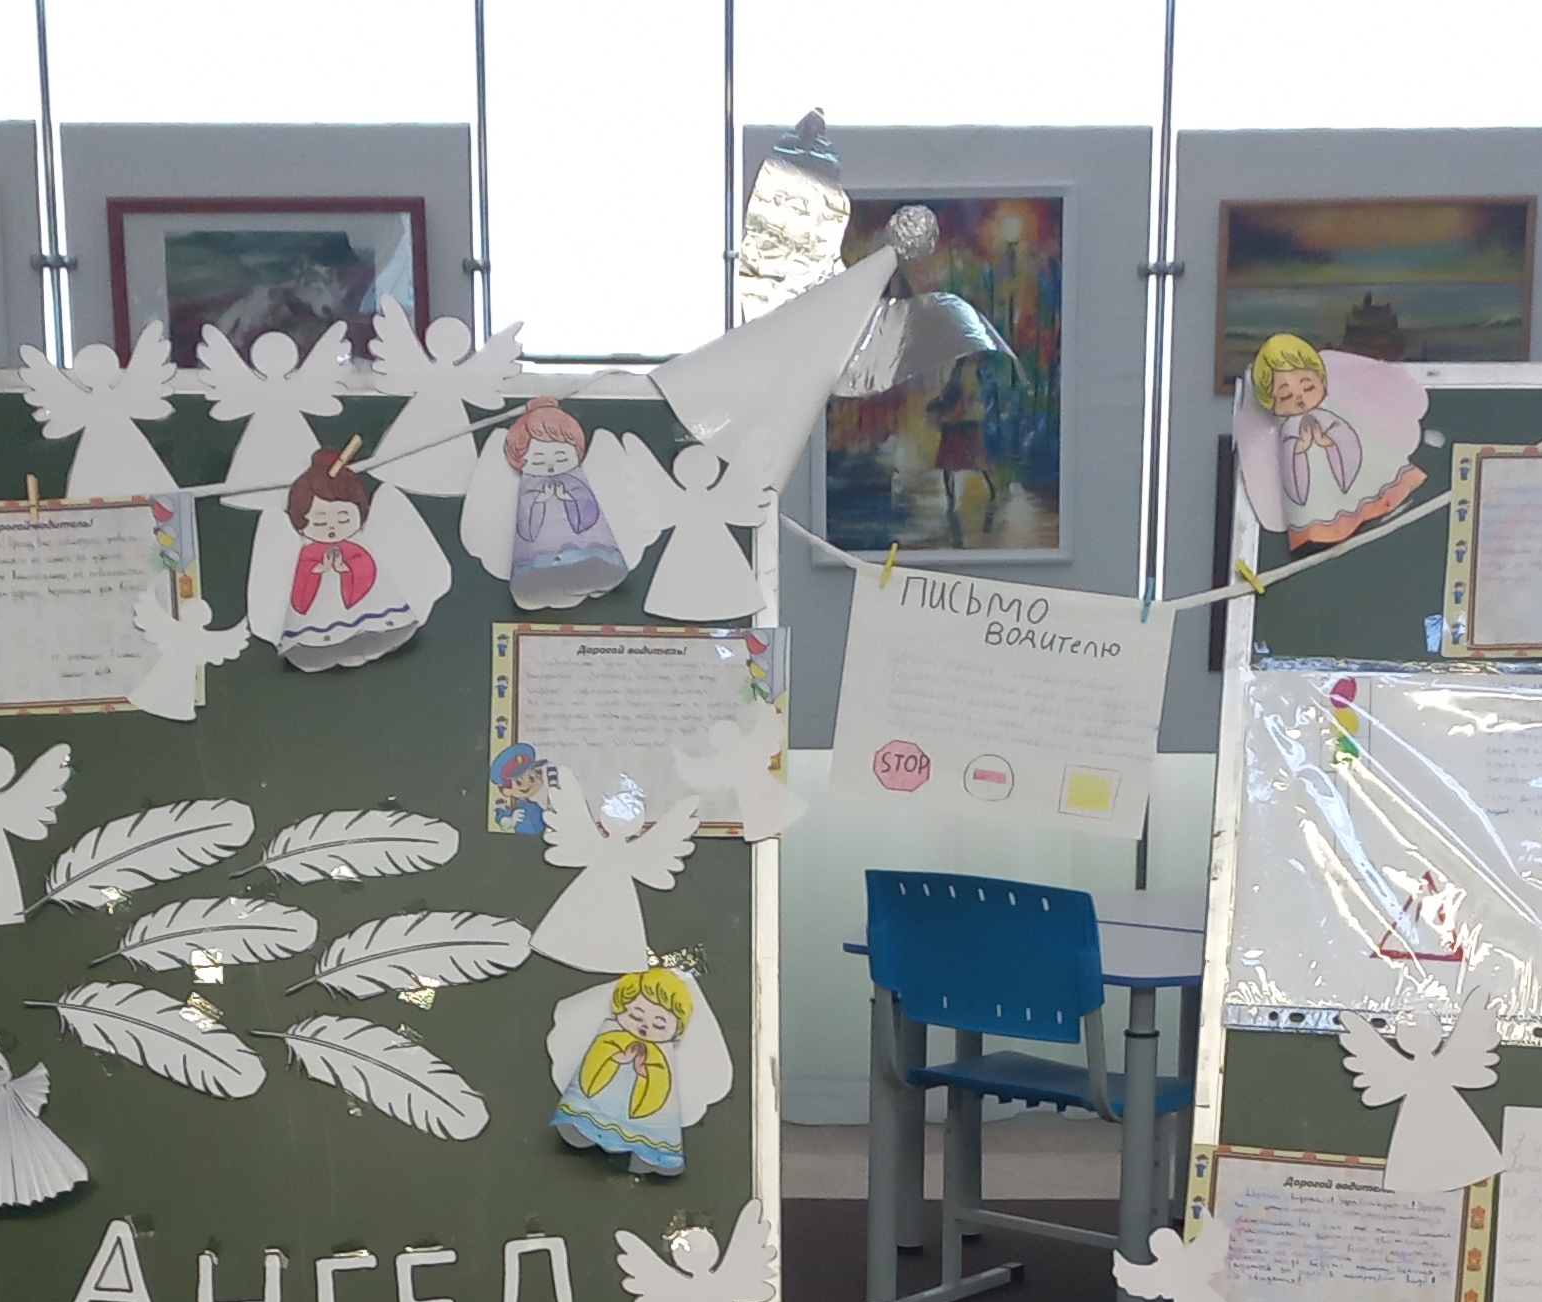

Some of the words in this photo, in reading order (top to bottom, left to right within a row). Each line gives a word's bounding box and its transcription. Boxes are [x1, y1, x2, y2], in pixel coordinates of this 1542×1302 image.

[901, 575, 1048, 624] ПИСЬМО
[576, 645, 625, 656] Дорогой
[881, 752, 930, 775] STOP
[1283, 1176, 1332, 1191] Дорогой
